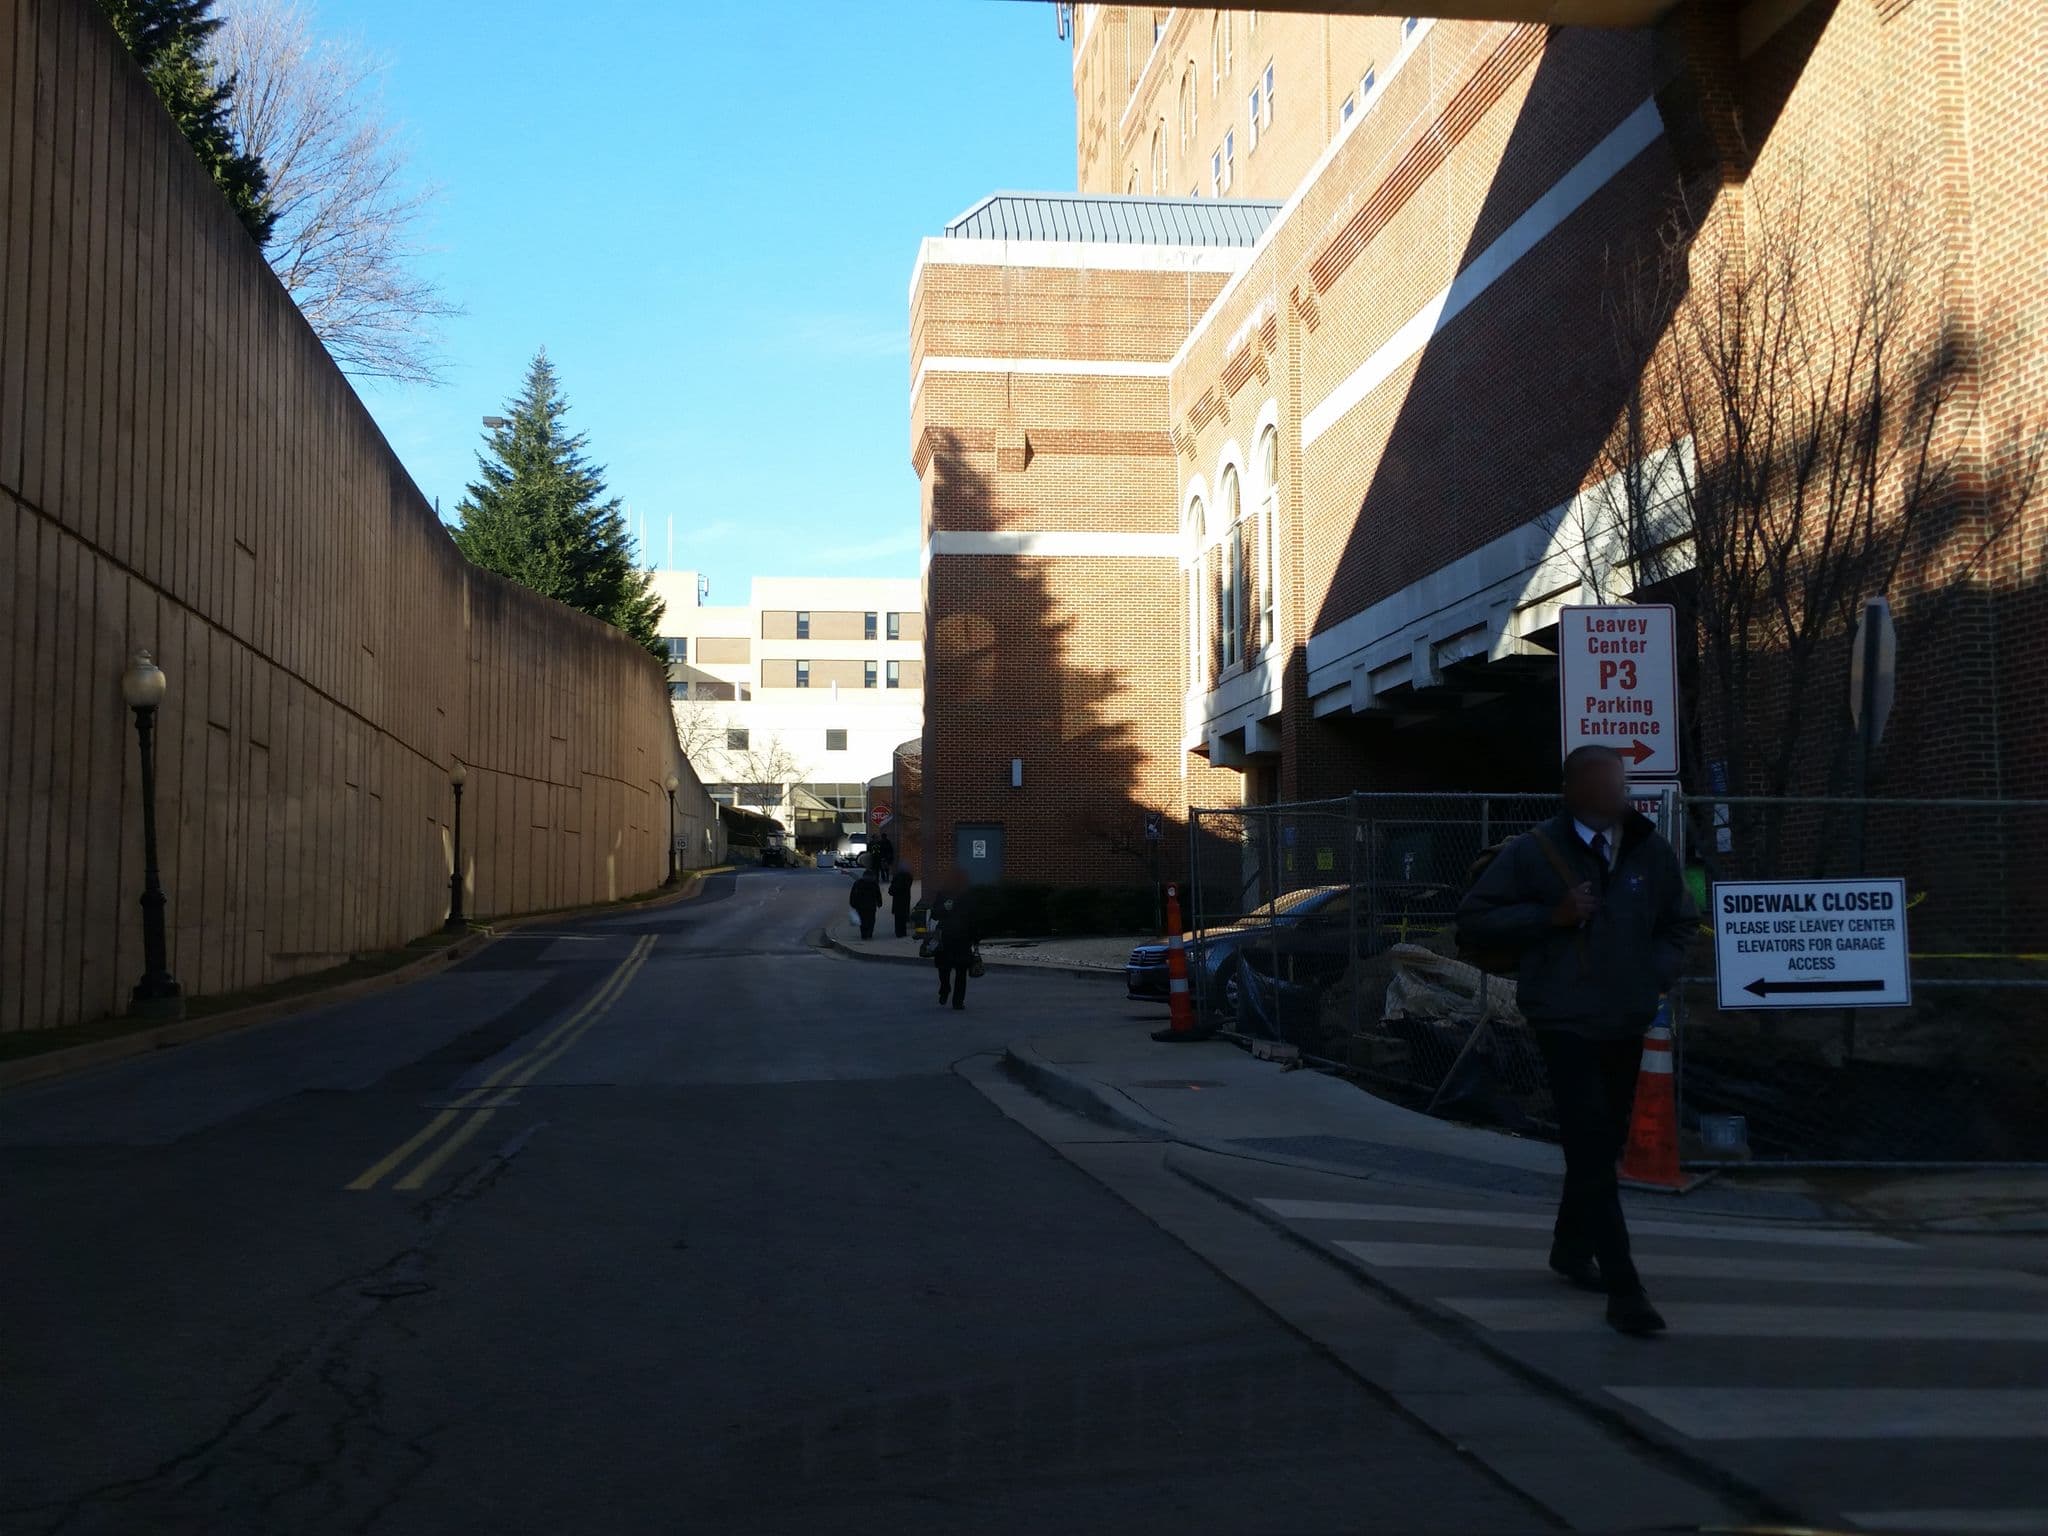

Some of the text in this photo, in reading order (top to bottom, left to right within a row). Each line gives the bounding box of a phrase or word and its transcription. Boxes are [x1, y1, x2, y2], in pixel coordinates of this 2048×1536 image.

[1586, 616, 1648, 635] Leavey
[1588, 637, 1648, 654] Center
[1600, 659, 1637, 690] P3
[1586, 696, 1654, 716] Parking
[1580, 718, 1660, 735] Entrance
[1723, 891, 1894, 914] SIDEWALK CLOSED
[1725, 918, 1896, 935] PLEASE USE LEAVEY CENTER
[1737, 937, 1886, 953] ELEVATORS FOR GARAGE
[1788, 957, 1836, 971] ACCESS
